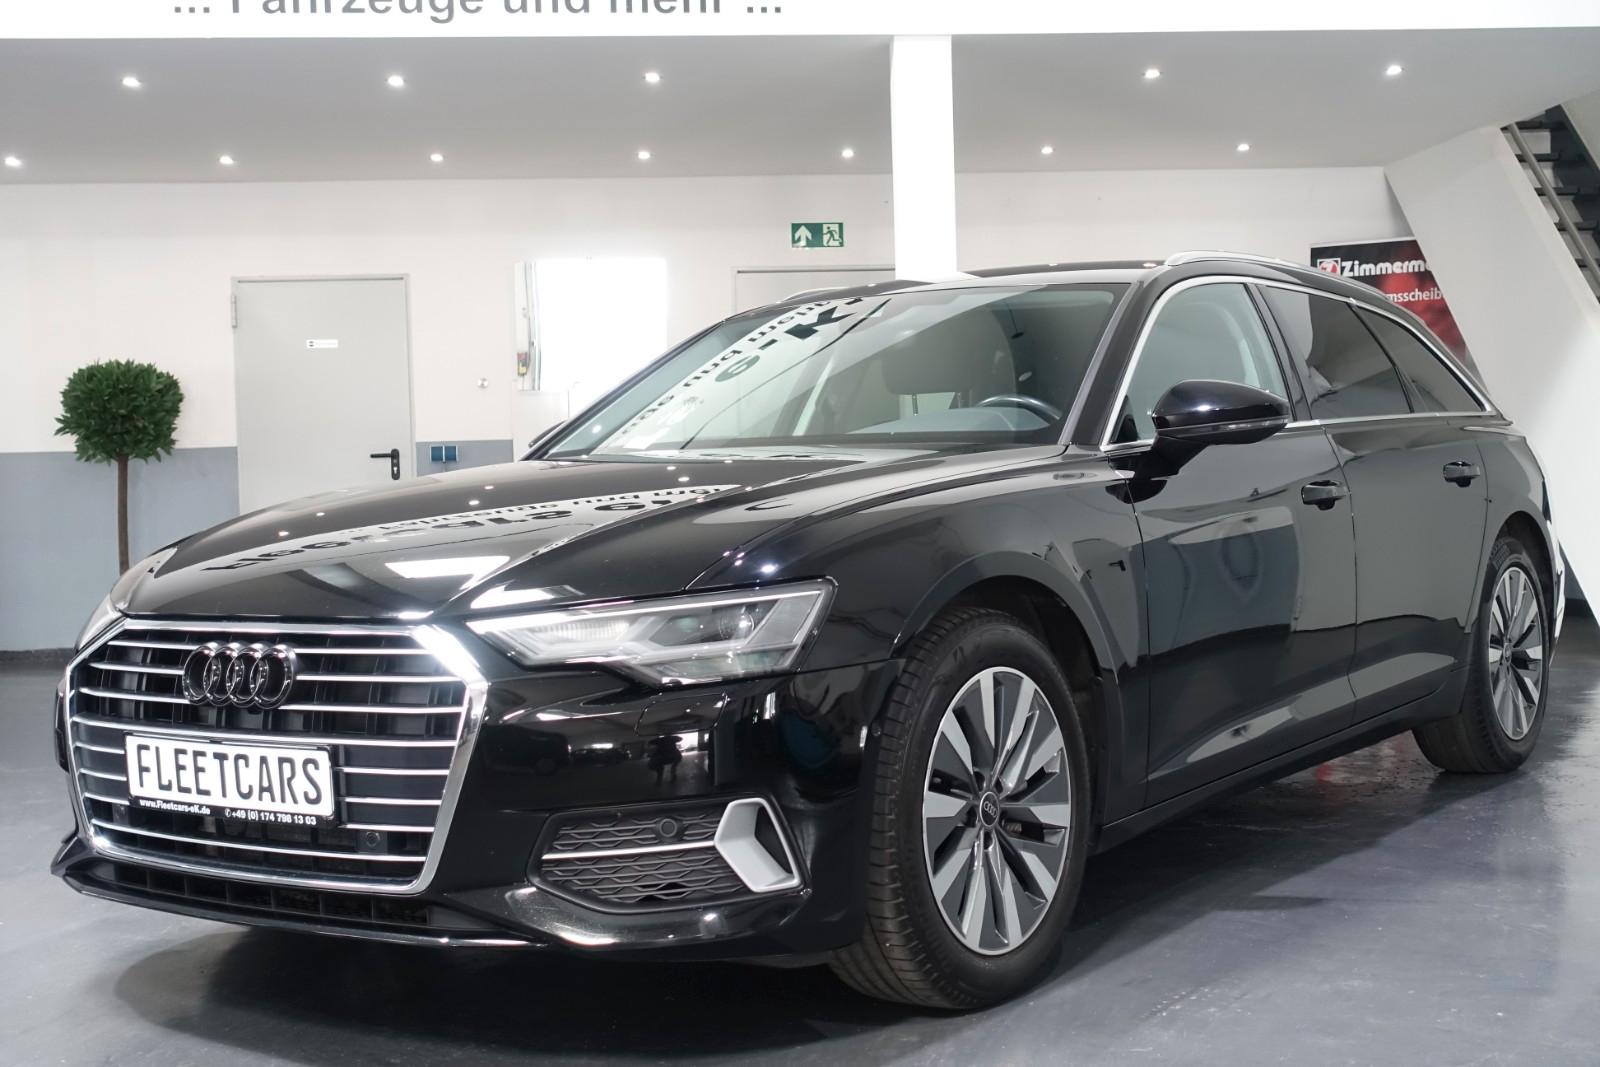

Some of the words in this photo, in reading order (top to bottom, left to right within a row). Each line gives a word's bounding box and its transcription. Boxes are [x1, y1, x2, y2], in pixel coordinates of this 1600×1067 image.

[1342, 259, 1431, 277] Zimmerm
[136, 743, 323, 806] FLEETCARS
[231, 809, 246, 819] +49
[248, 810, 259, 821] (0)
[260, 812, 275, 822] 174
[294, 815, 304, 825] 13
[305, 816, 317, 826] 03
